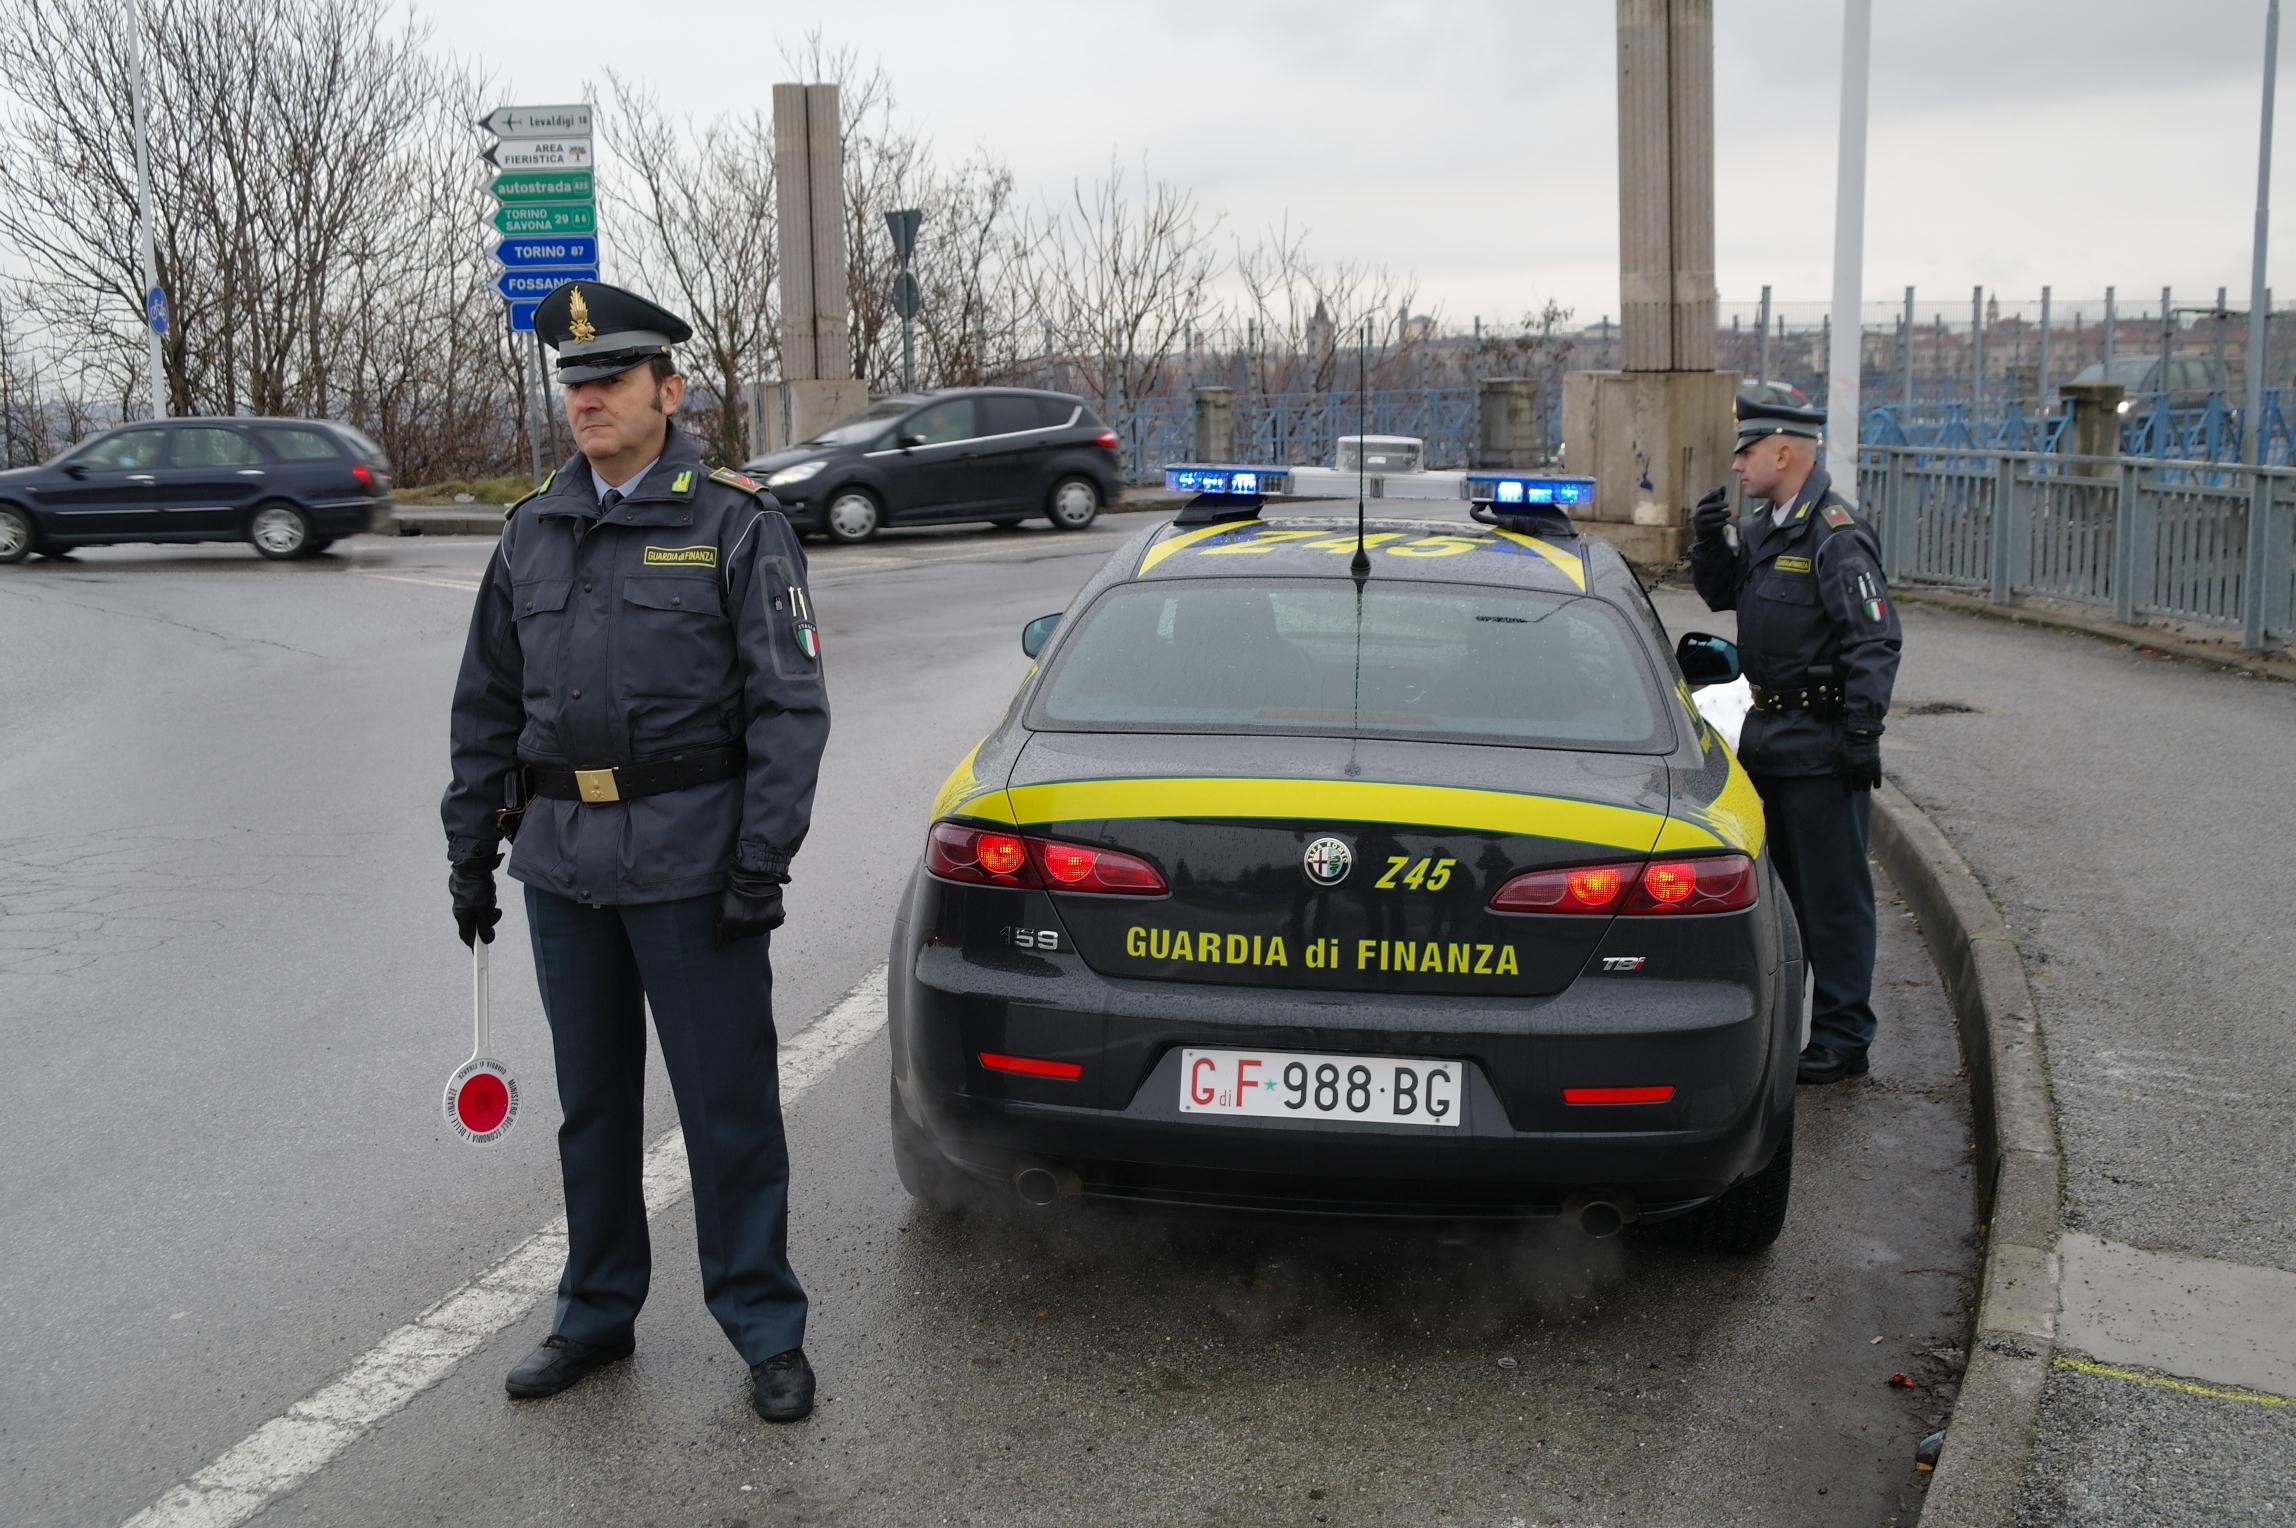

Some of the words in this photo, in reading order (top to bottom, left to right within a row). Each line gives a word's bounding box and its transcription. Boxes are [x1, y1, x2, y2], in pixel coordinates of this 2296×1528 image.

[535, 144, 564, 153] AREA
[505, 154, 564, 164] FIERISTICA
[498, 180, 572, 194] autostrada
[504, 209, 548, 219] TORINO
[505, 220, 553, 231] SAVONA
[514, 245, 566, 258] TORINO
[647, 551, 678, 561] GUARDIA
[685, 551, 714, 562] FINANZA
[1374, 855, 1457, 891] Z45
[1126, 926, 1289, 967] GUARDIA
[1305, 938, 1340, 969] di
[1357, 939, 1519, 975] FINANZA
